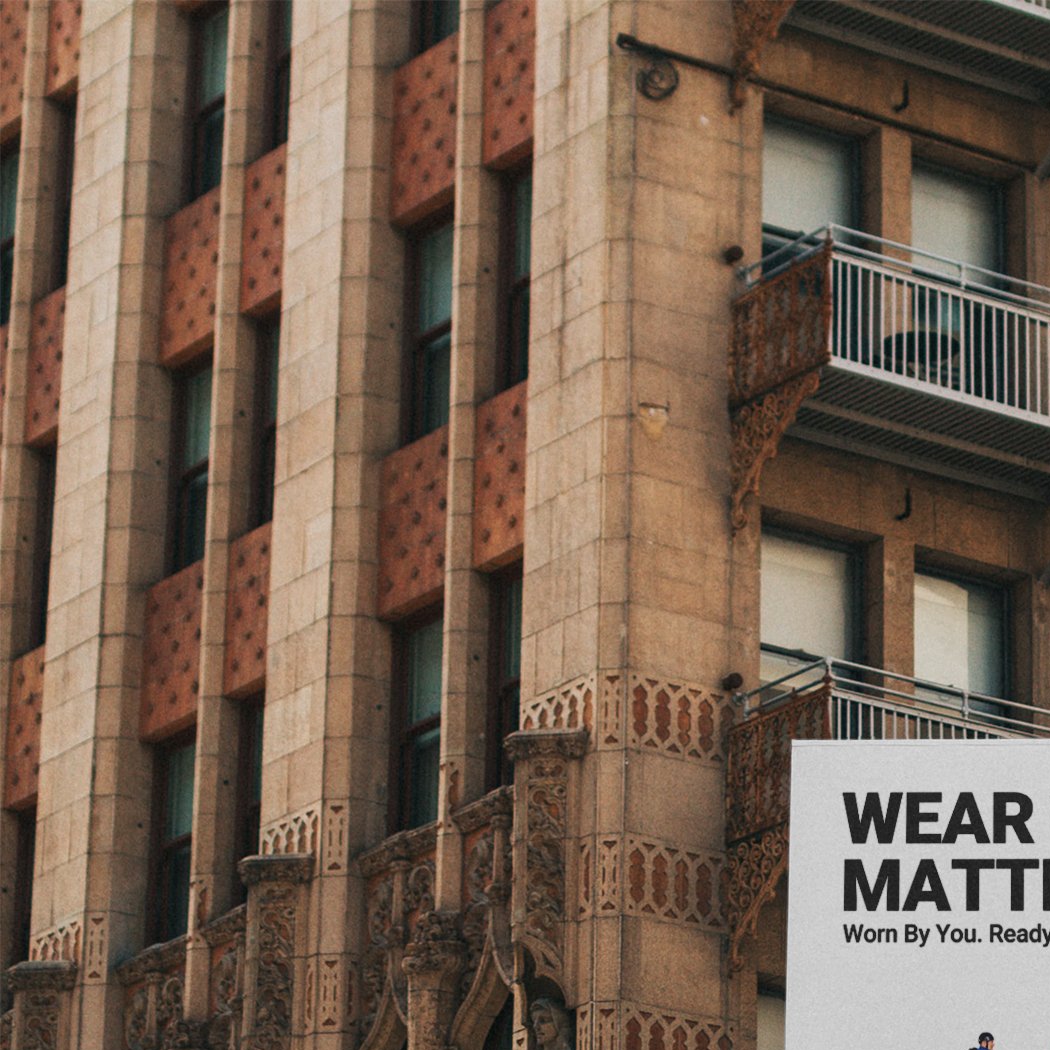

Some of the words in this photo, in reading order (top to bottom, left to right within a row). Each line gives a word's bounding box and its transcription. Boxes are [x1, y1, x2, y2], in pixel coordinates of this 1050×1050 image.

[842, 791, 1035, 844] WEAR
[843, 924, 898, 944] Worn
[904, 924, 931, 948] By
[935, 924, 982, 944] You.
